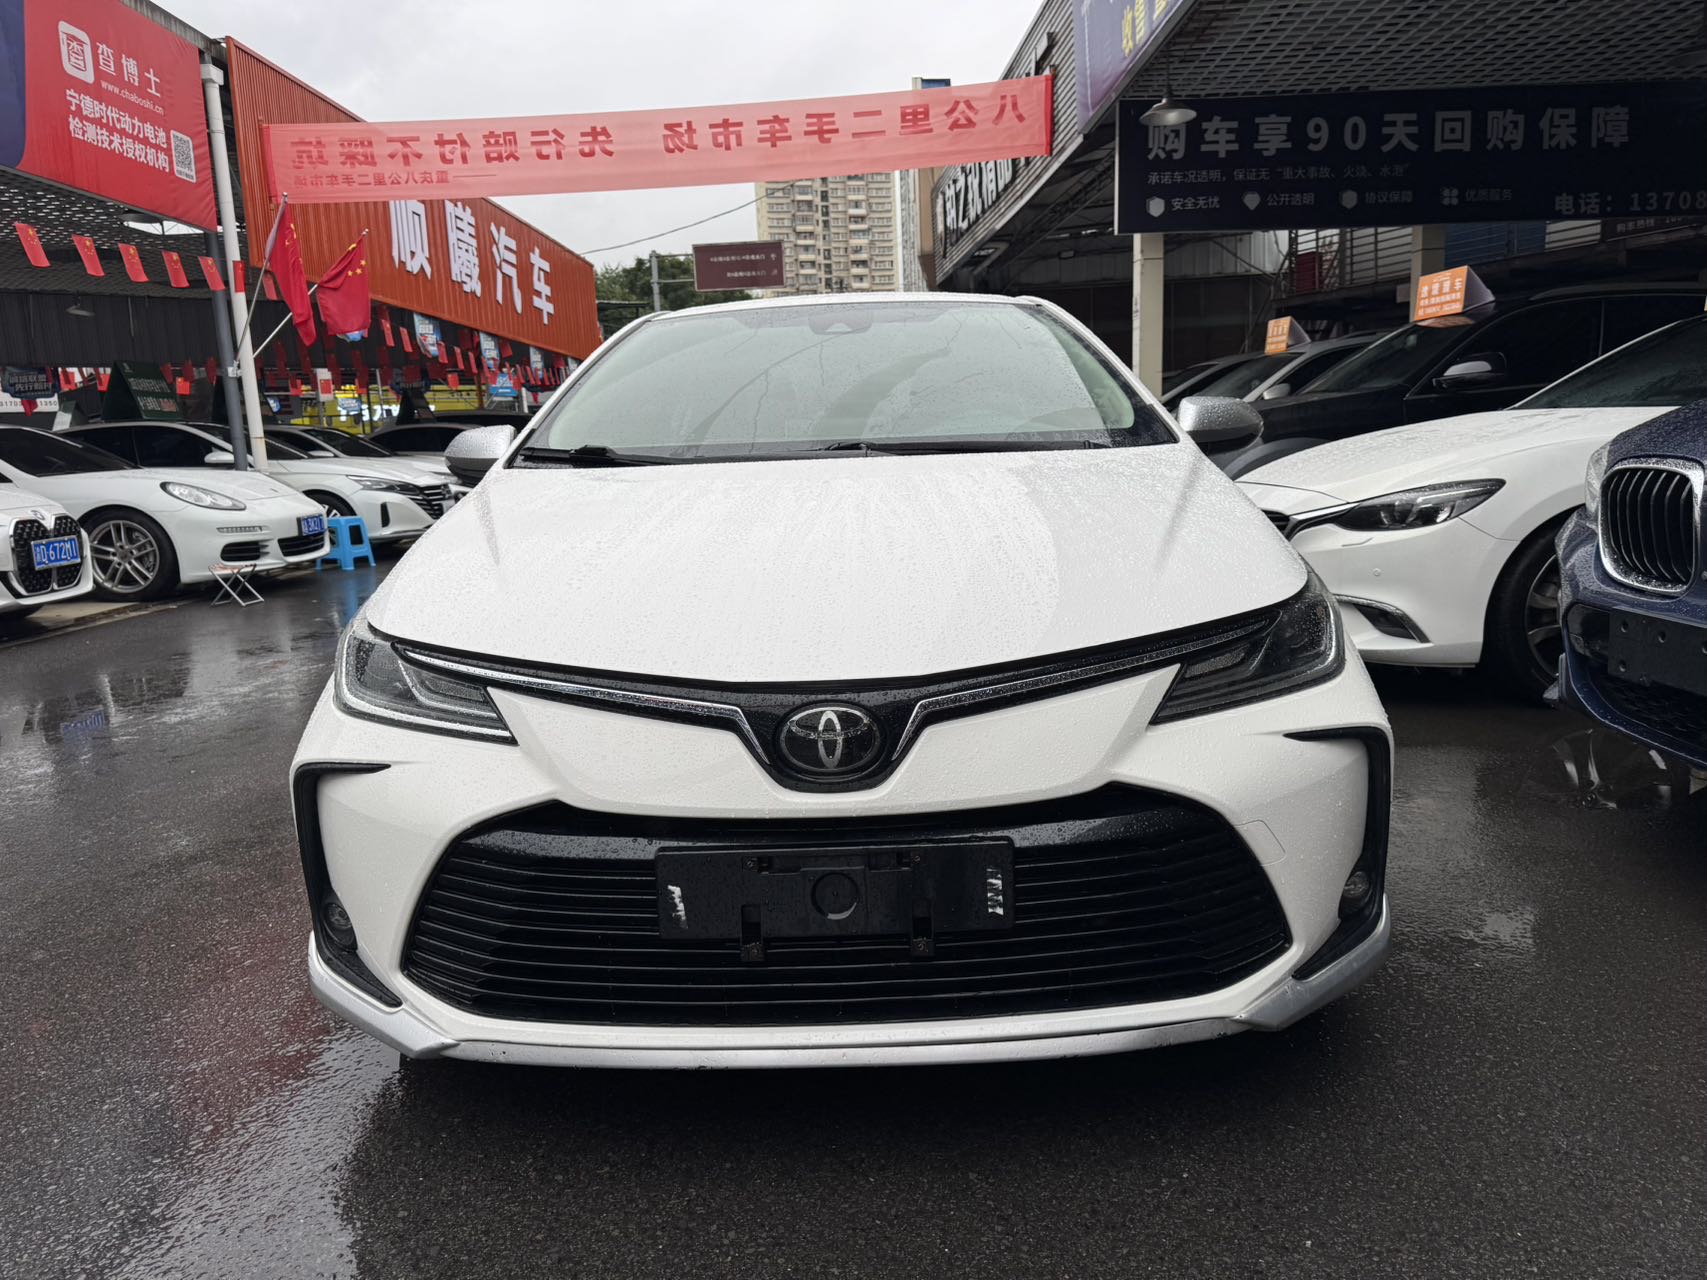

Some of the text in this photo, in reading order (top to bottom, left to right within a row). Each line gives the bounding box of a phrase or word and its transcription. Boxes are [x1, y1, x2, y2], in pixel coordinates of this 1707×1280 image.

[95, 41, 161, 98] 查博士
[100, 79, 164, 116] www.chaboshi.cn
[65, 89, 168, 149] 宁德时代动力电池
[68, 114, 169, 173] 检测技术授权机构
[1147, 104, 1631, 160] 购车享90天回购保障
[1171, 195, 1221, 211] 安全无忧
[1266, 192, 1315, 206] 公开透明
[389, 199, 555, 325] 顺曦汽车
